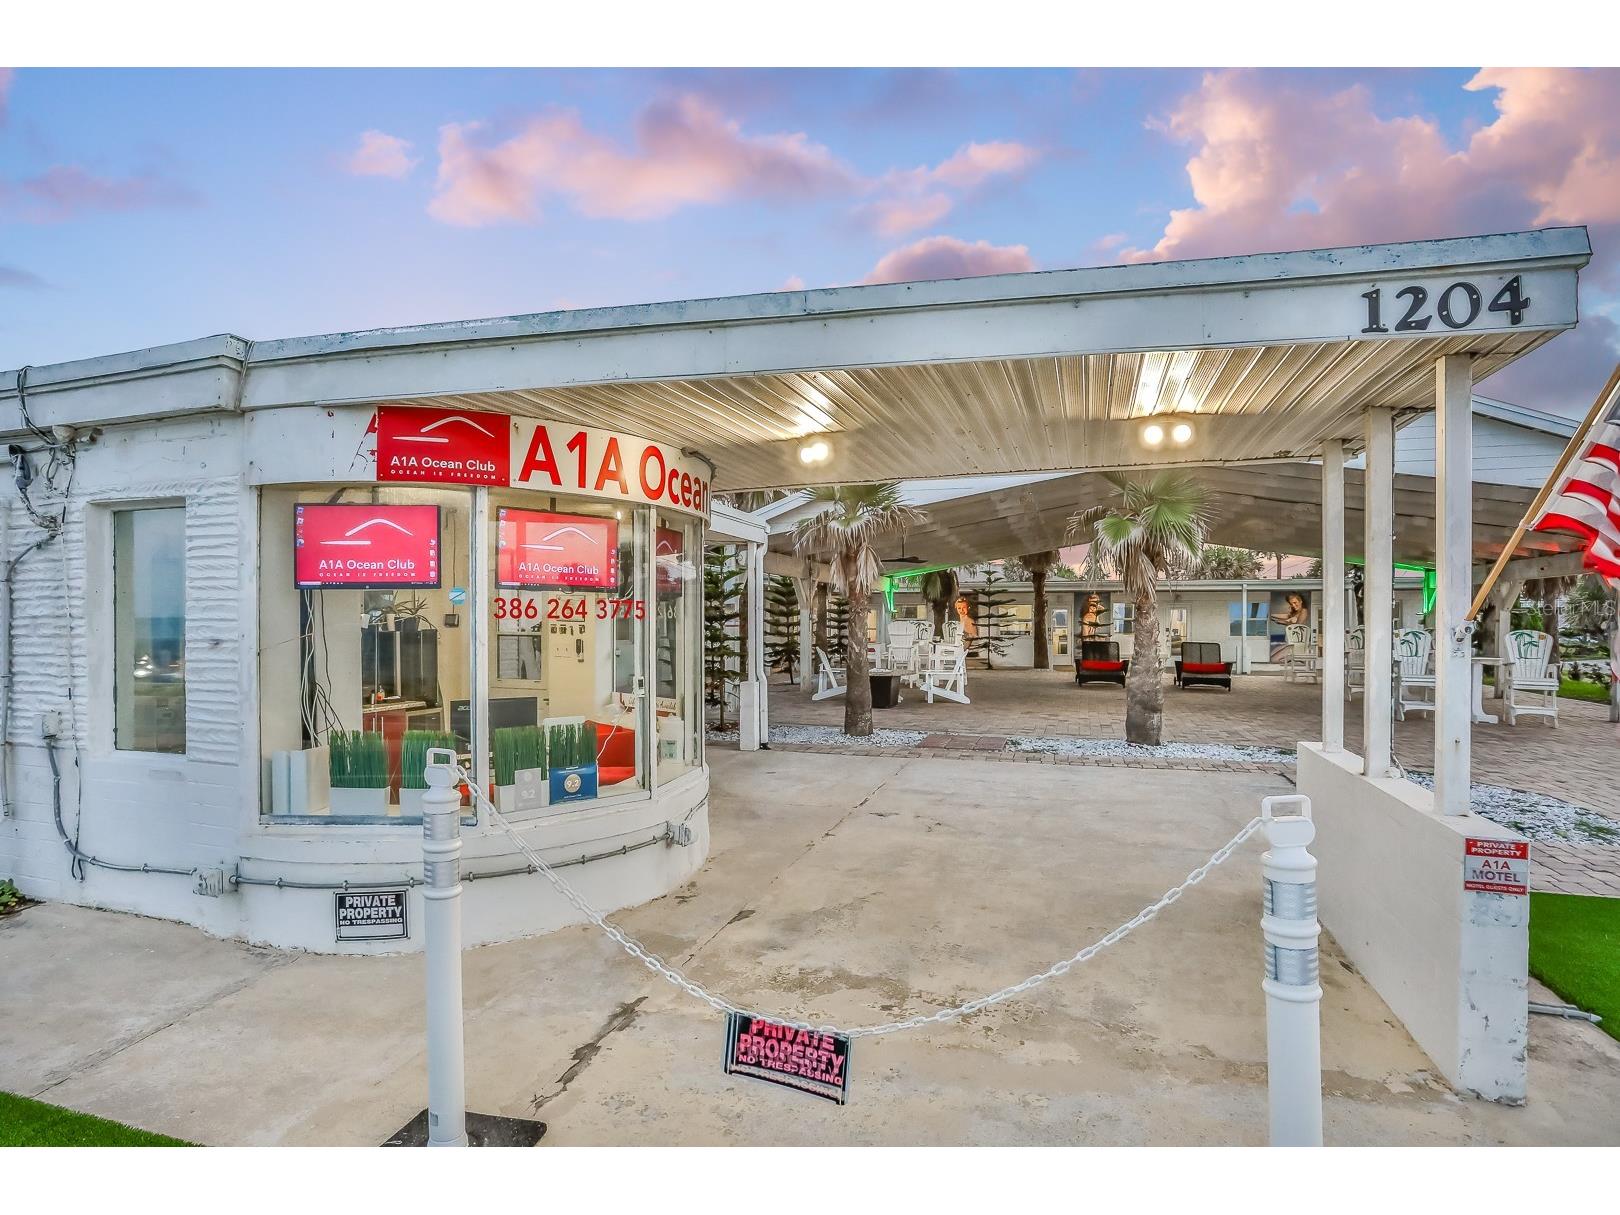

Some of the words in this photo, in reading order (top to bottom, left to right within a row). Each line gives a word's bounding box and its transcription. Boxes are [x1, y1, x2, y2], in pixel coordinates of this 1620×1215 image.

[1361, 275, 1531, 333] 1204
[390, 456, 418, 467] A1A
[421, 457, 463, 469] Ocean
[466, 460, 496, 472] Club
[518, 425, 629, 494] A1A
[639, 445, 708, 513] Ocean
[450, 472, 496, 480] FREEDOM
[319, 559, 344, 570] A1A
[346, 559, 384, 570] Ocean
[387, 559, 415, 570] Club
[518, 562, 541, 572] A1A
[543, 563, 574, 574] Ocean
[576, 564, 599, 575] Club
[494, 597, 538, 620] 386
[547, 598, 588, 620] 264
[596, 600, 646, 621] 3775
[1471, 847, 1521, 856] PROPERTY
[1477, 842, 1516, 850] PRIVATE
[1482, 860, 1511, 870] A1A
[1472, 870, 1520, 882] MOTEL
[345, 895, 396, 907] PRIVATE
[339, 906, 402, 920] PROPERTY
[751, 1018, 835, 1051] PRIVATE
[739, 1033, 845, 1075] PROPERTY
[738, 1055, 756, 1064] NO
[760, 1058, 843, 1085] TRESPASSING
